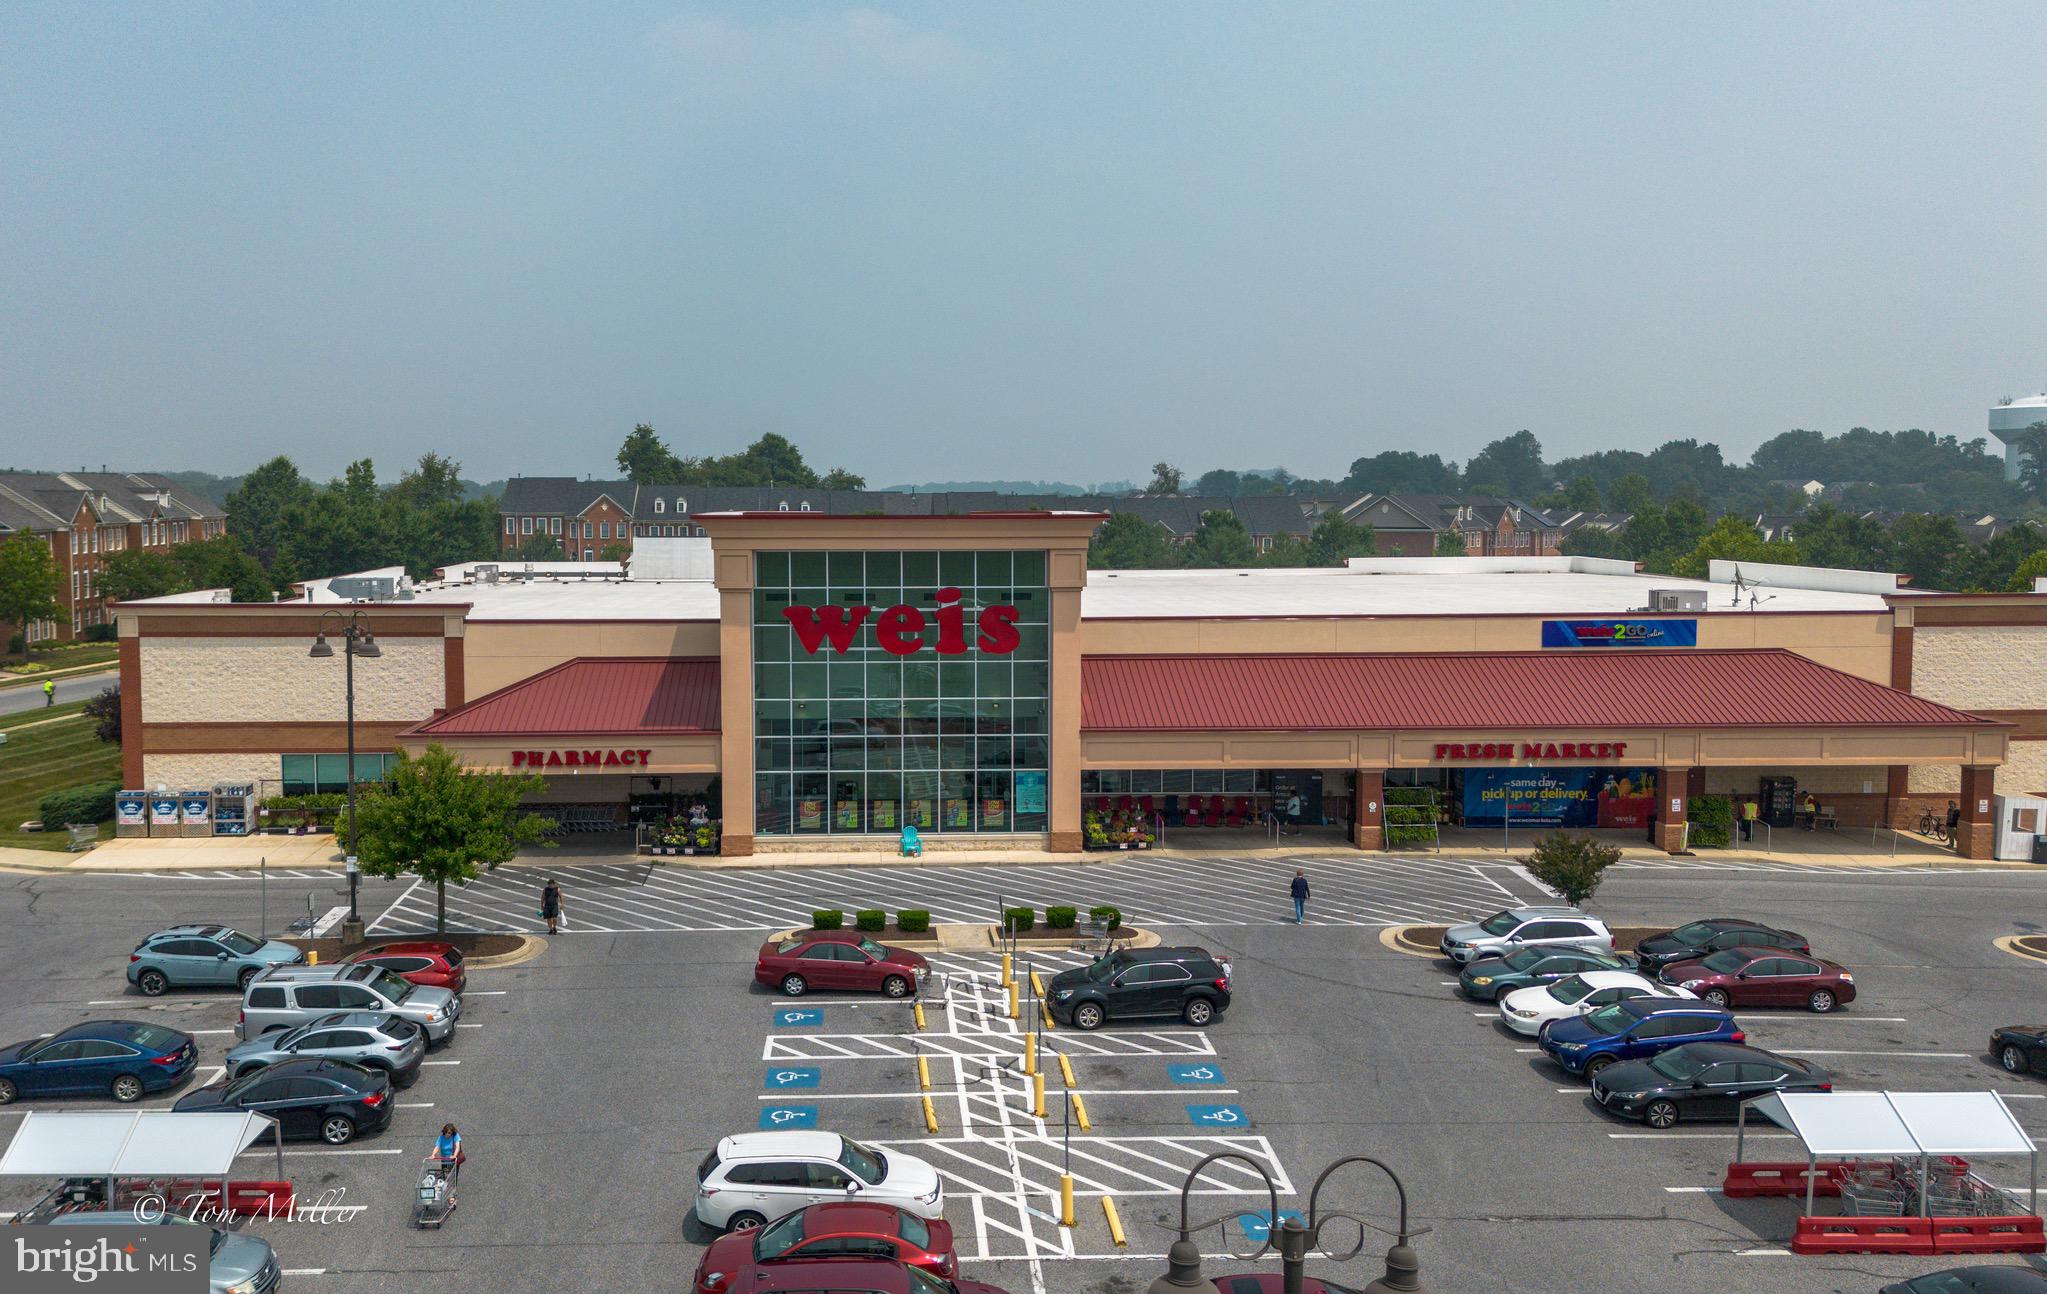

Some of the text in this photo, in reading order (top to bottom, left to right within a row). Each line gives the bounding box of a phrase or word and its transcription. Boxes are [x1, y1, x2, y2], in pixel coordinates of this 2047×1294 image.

[782, 587, 1021, 655] weis
[512, 750, 652, 767] PHARMACY
[1434, 743, 1627, 759] FRESH MARKET
[1511, 777, 1557, 789] same day
[1525, 790, 1537, 799] or
